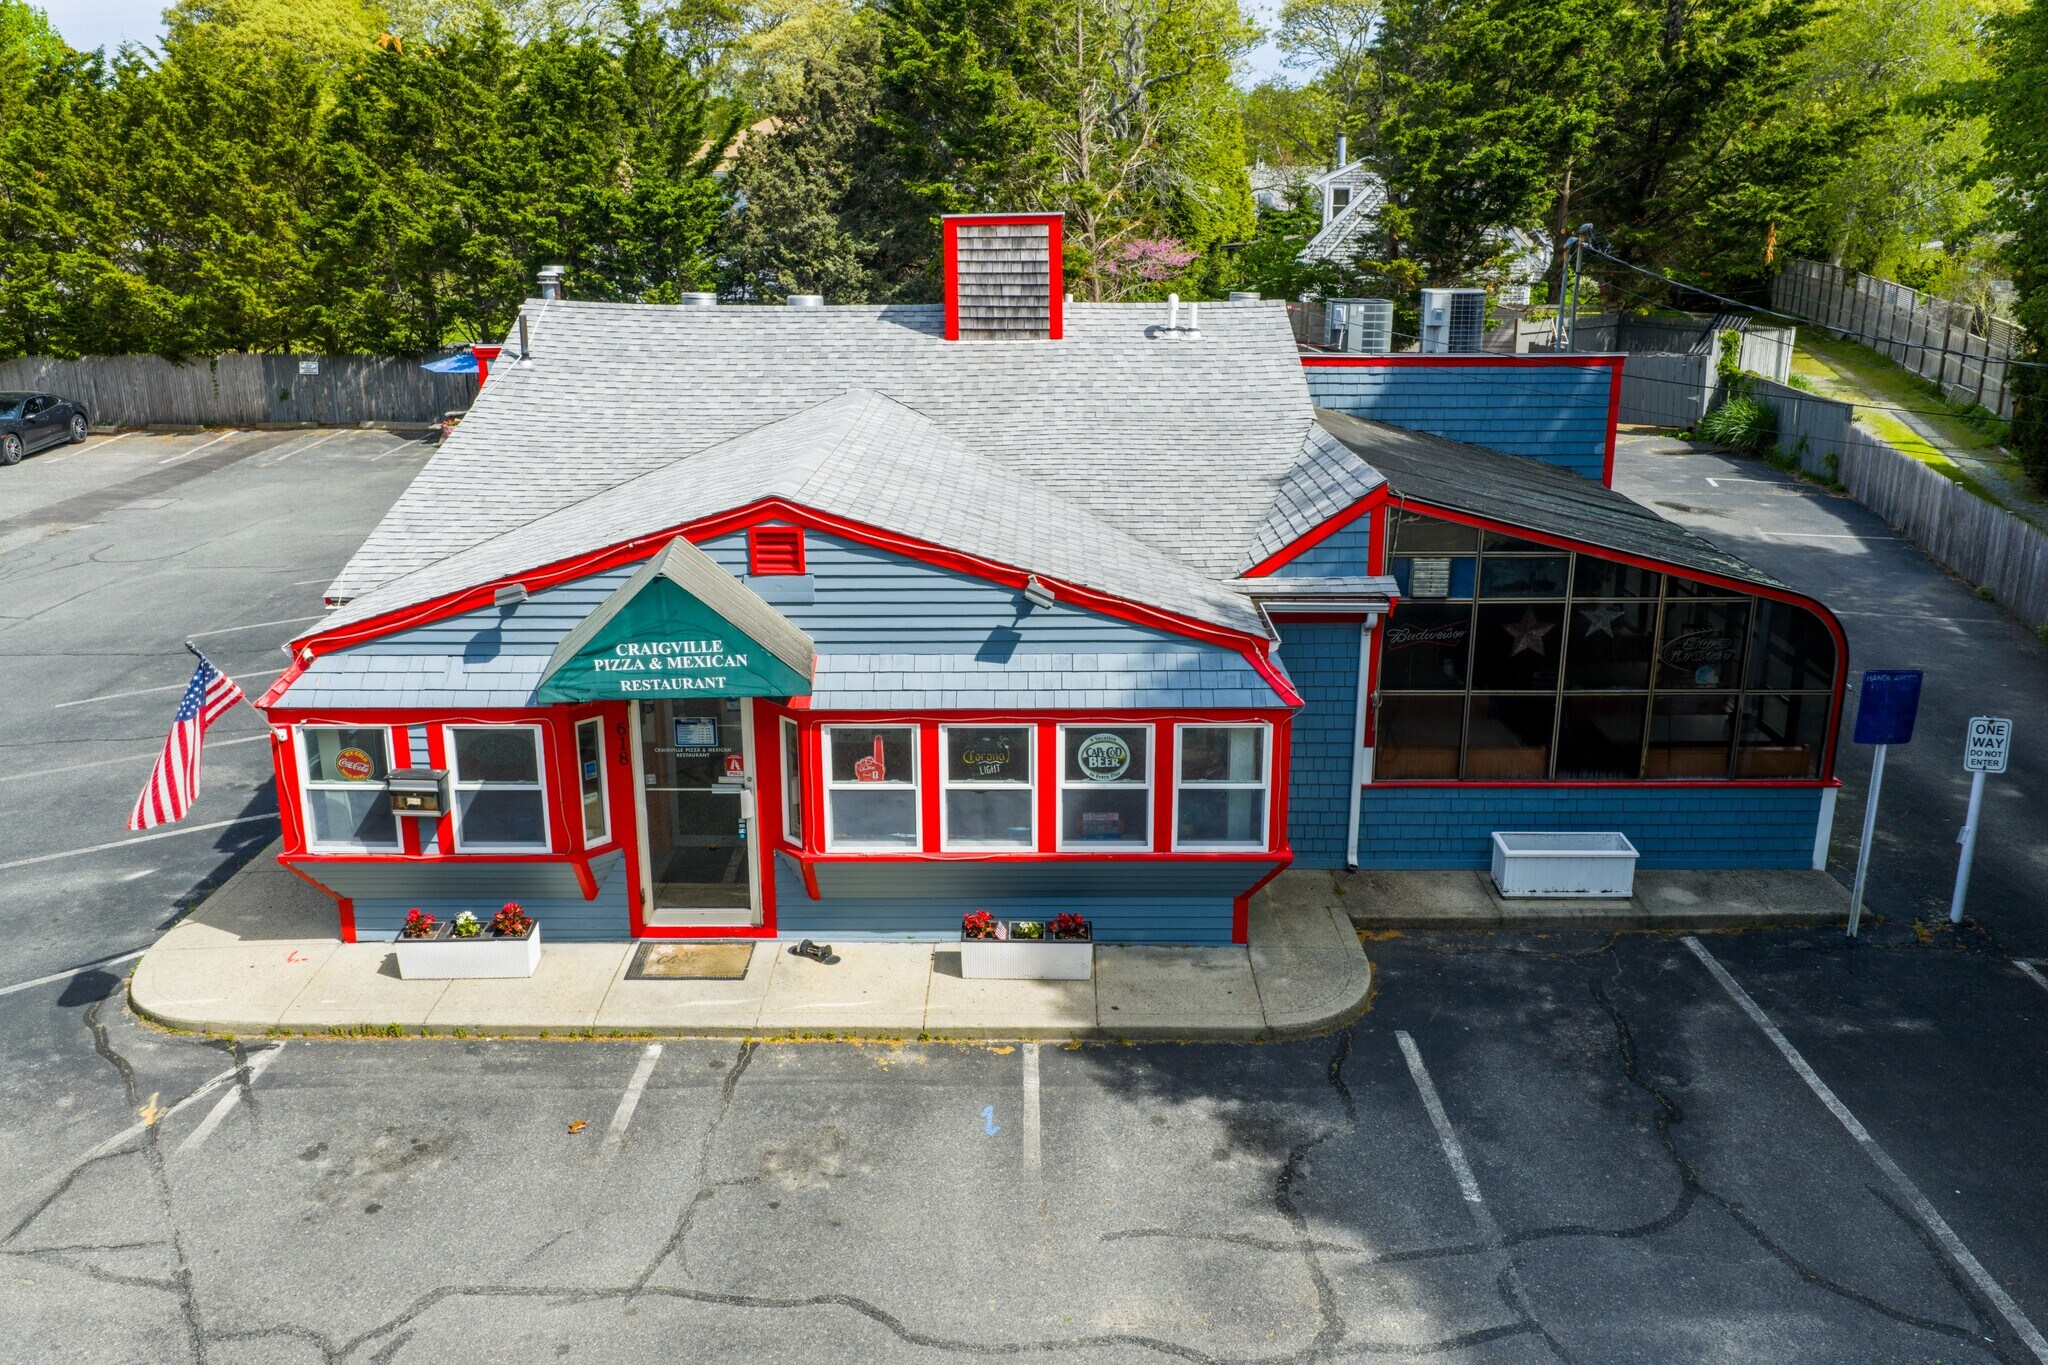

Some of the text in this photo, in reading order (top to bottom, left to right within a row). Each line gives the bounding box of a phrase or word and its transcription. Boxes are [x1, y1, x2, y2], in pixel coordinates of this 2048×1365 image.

[1386, 627, 1468, 643] Budweiser
[615, 639, 723, 656] CRAIGVILLE
[593, 654, 748, 672] PIZZA & MEXICAN
[620, 676, 726, 692] RESTAURANT
[1976, 724, 2005, 736] ONE
[1972, 737, 2004, 748] WAY
[963, 750, 1009, 764] Corona
[1970, 749, 2003, 758] DO NOT
[1088, 757, 1121, 768] BEER
[1970, 758, 1999, 767] ENTER
[979, 764, 1000, 775] LIGHT
